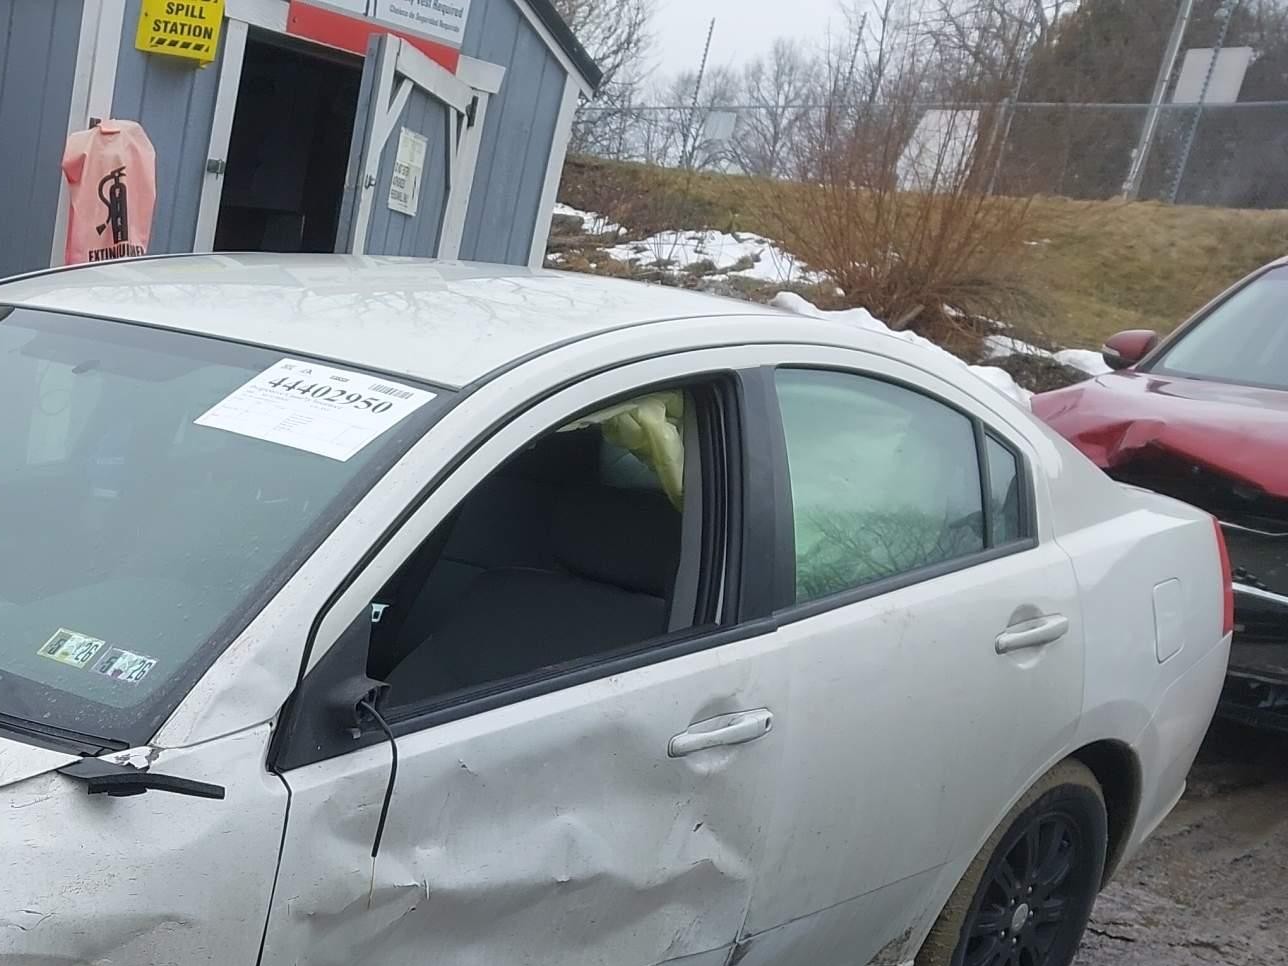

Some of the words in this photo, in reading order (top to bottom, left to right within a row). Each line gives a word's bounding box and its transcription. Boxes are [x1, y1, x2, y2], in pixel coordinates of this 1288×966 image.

[165, 2, 206, 20] SPILL
[152, 19, 213, 40] STATION
[268, 376, 393, 414] 44402950
